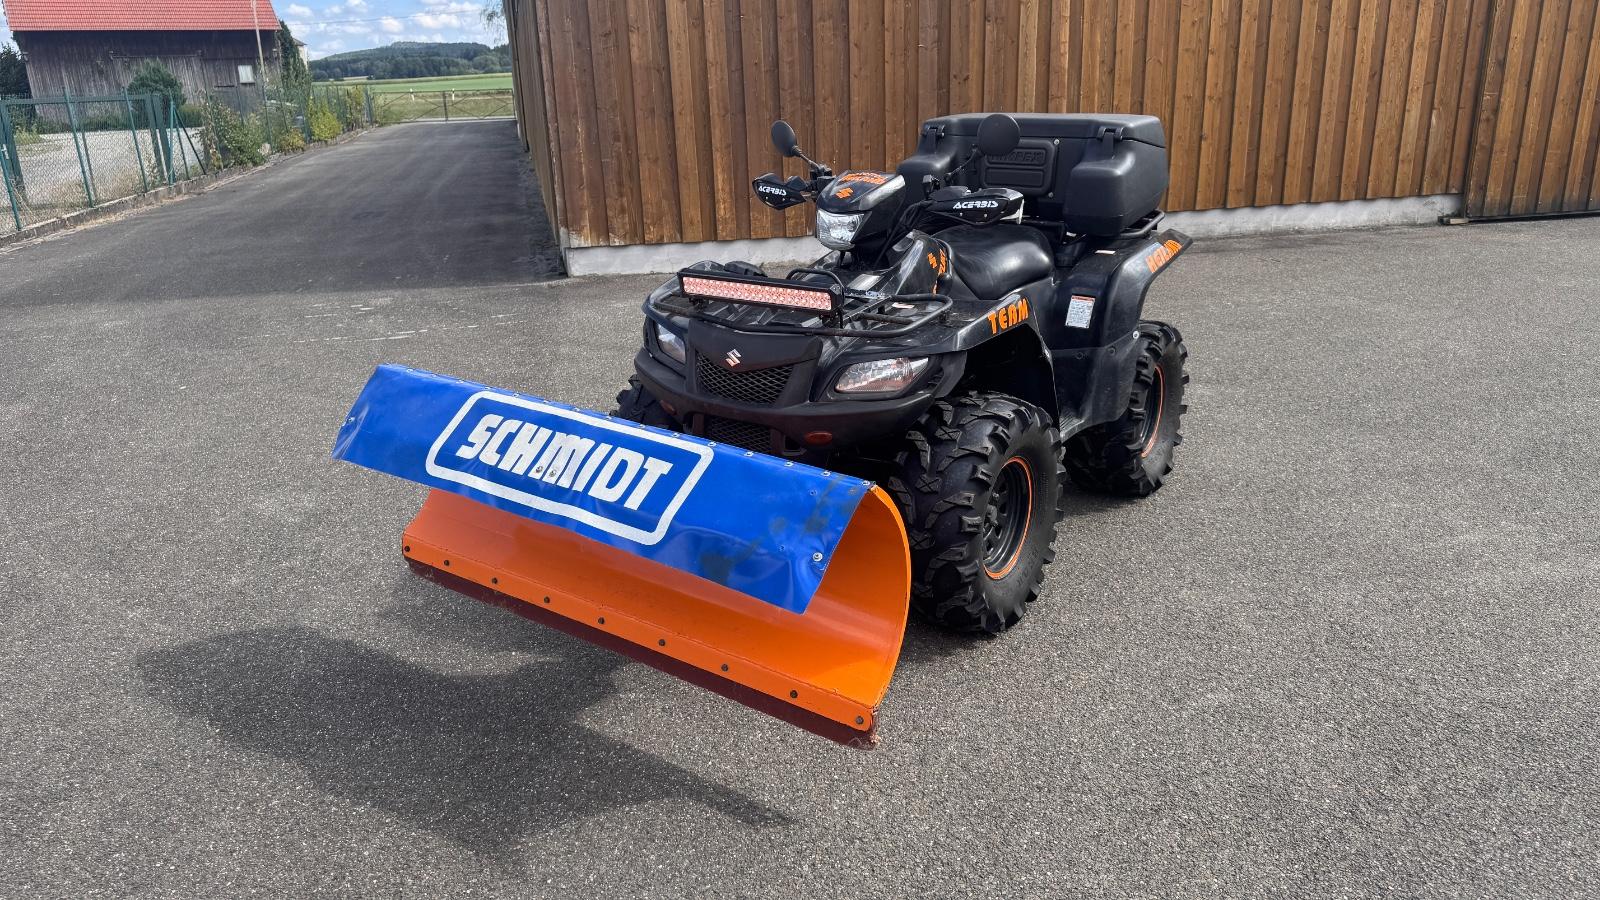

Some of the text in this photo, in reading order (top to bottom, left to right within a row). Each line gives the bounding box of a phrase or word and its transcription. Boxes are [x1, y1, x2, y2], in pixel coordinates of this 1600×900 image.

[758, 186, 787, 196] ACERBIS
[953, 200, 999, 209] ACERBIS
[987, 297, 1029, 334] TEAM
[455, 413, 674, 511] SCHMIDT
